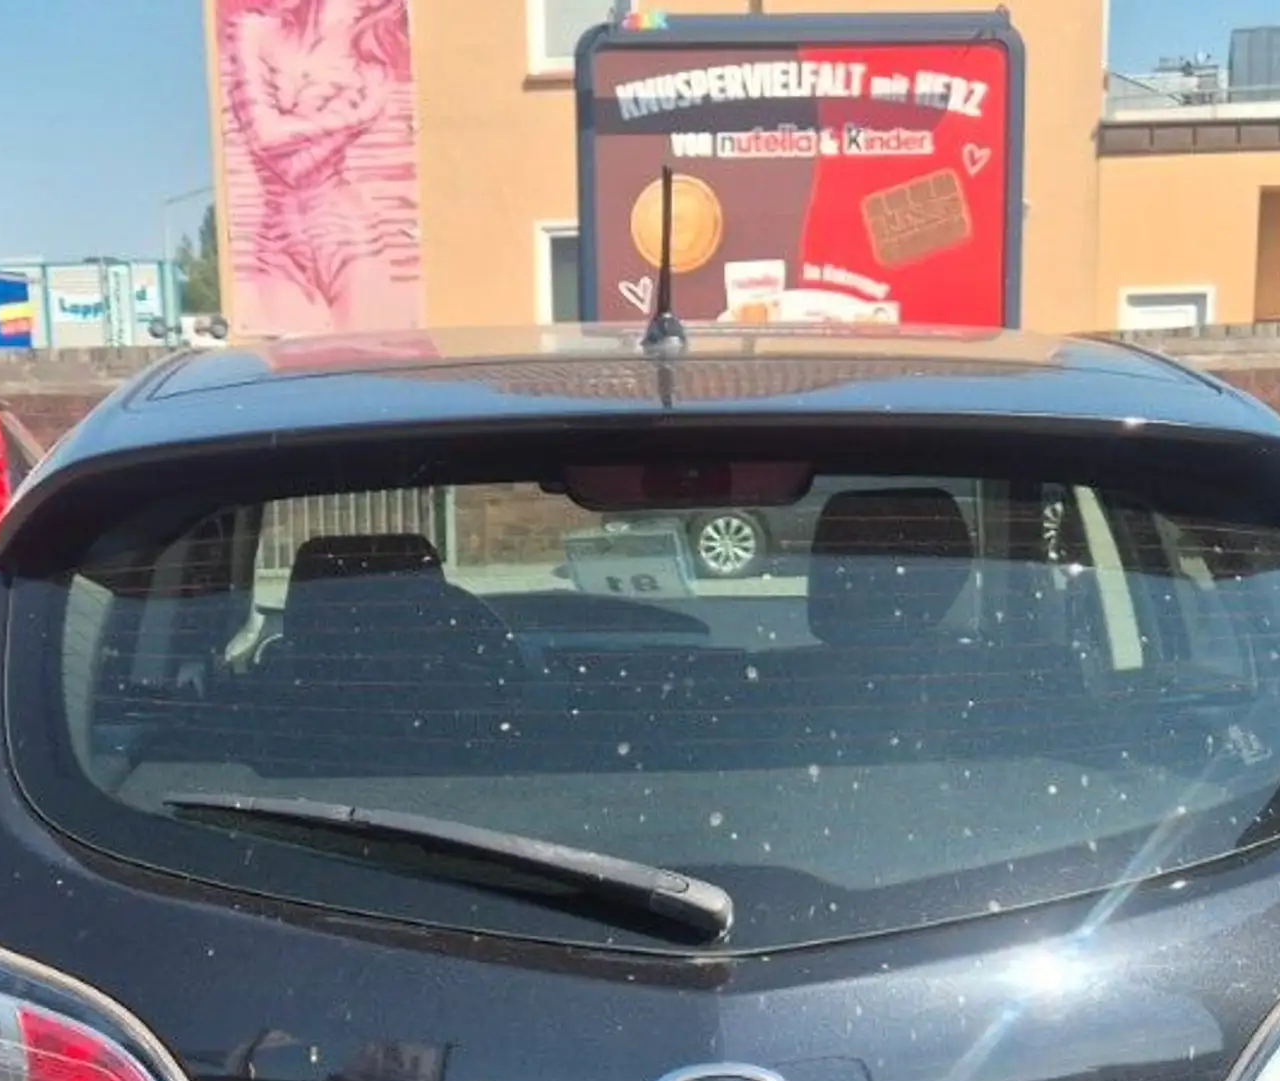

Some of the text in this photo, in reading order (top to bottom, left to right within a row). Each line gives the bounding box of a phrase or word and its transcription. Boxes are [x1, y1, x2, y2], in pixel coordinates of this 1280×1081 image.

[615, 60, 867, 121] KNUSPERVIELFALT
[914, 70, 988, 118] HERZ
[719, 125, 816, 157] nutella
[845, 123, 930, 153] Kinder
